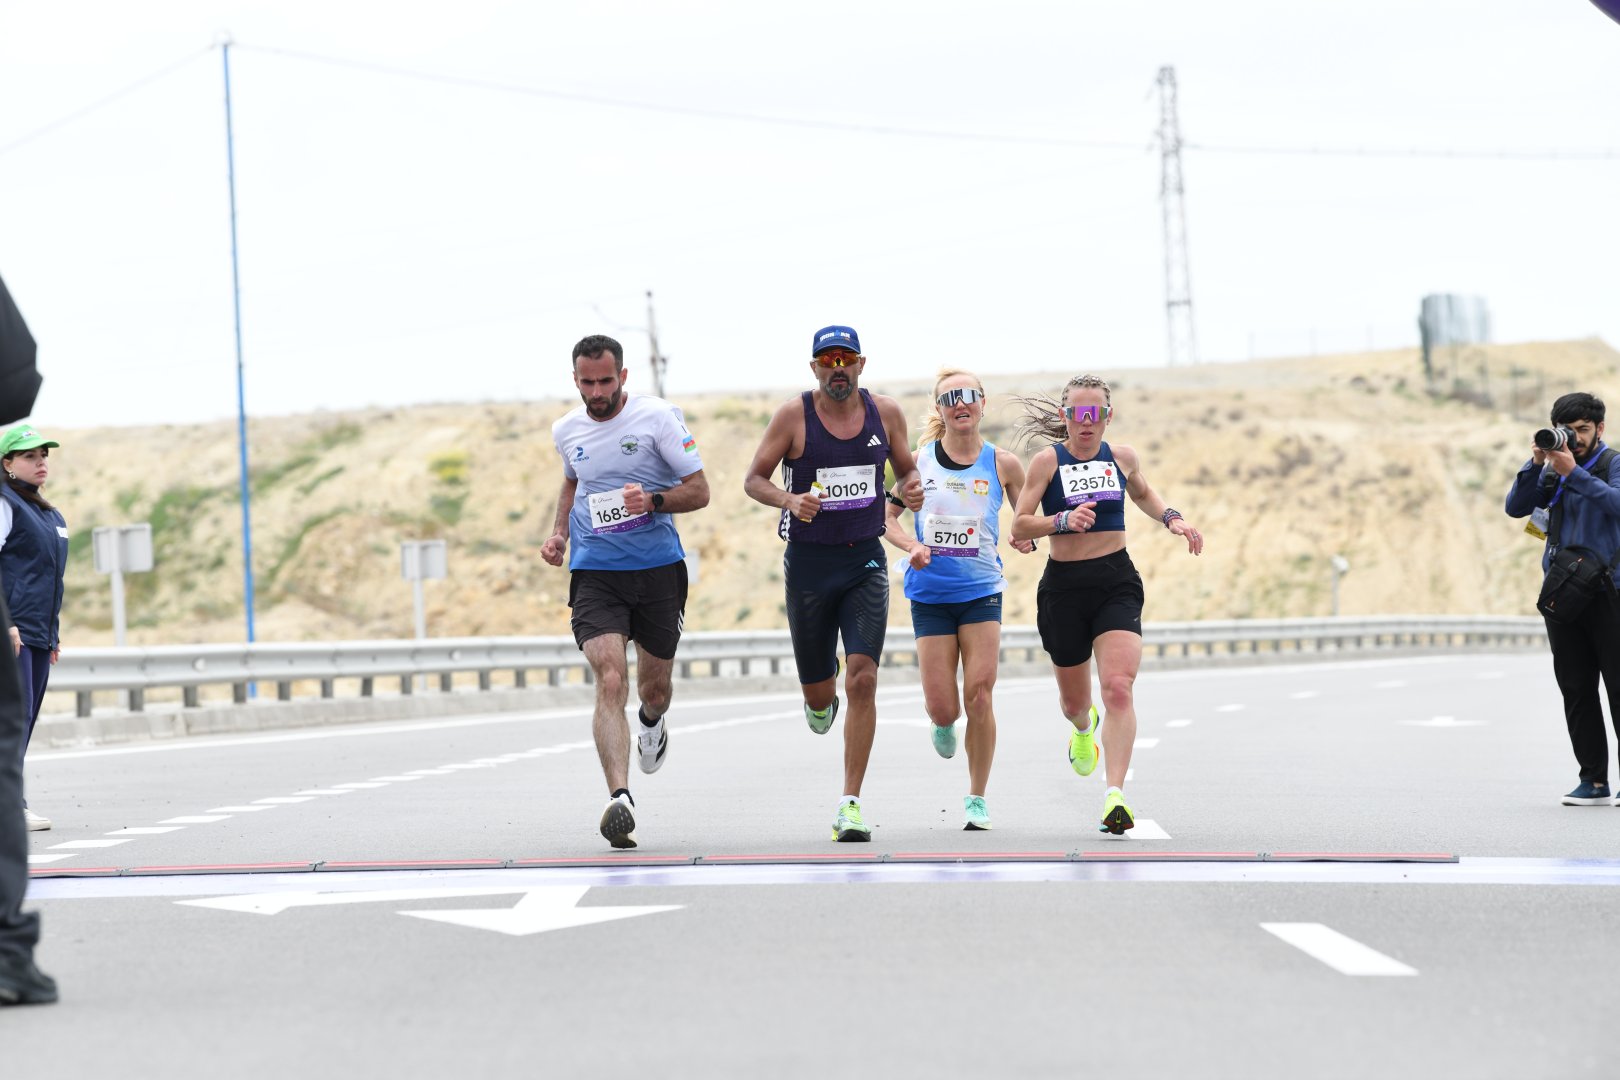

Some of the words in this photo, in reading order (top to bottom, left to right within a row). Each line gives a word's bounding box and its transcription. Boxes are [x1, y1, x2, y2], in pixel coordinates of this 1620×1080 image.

[825, 481, 868, 498] 10109
[1069, 476, 1116, 492] 23576
[934, 531, 969, 546] 5710
